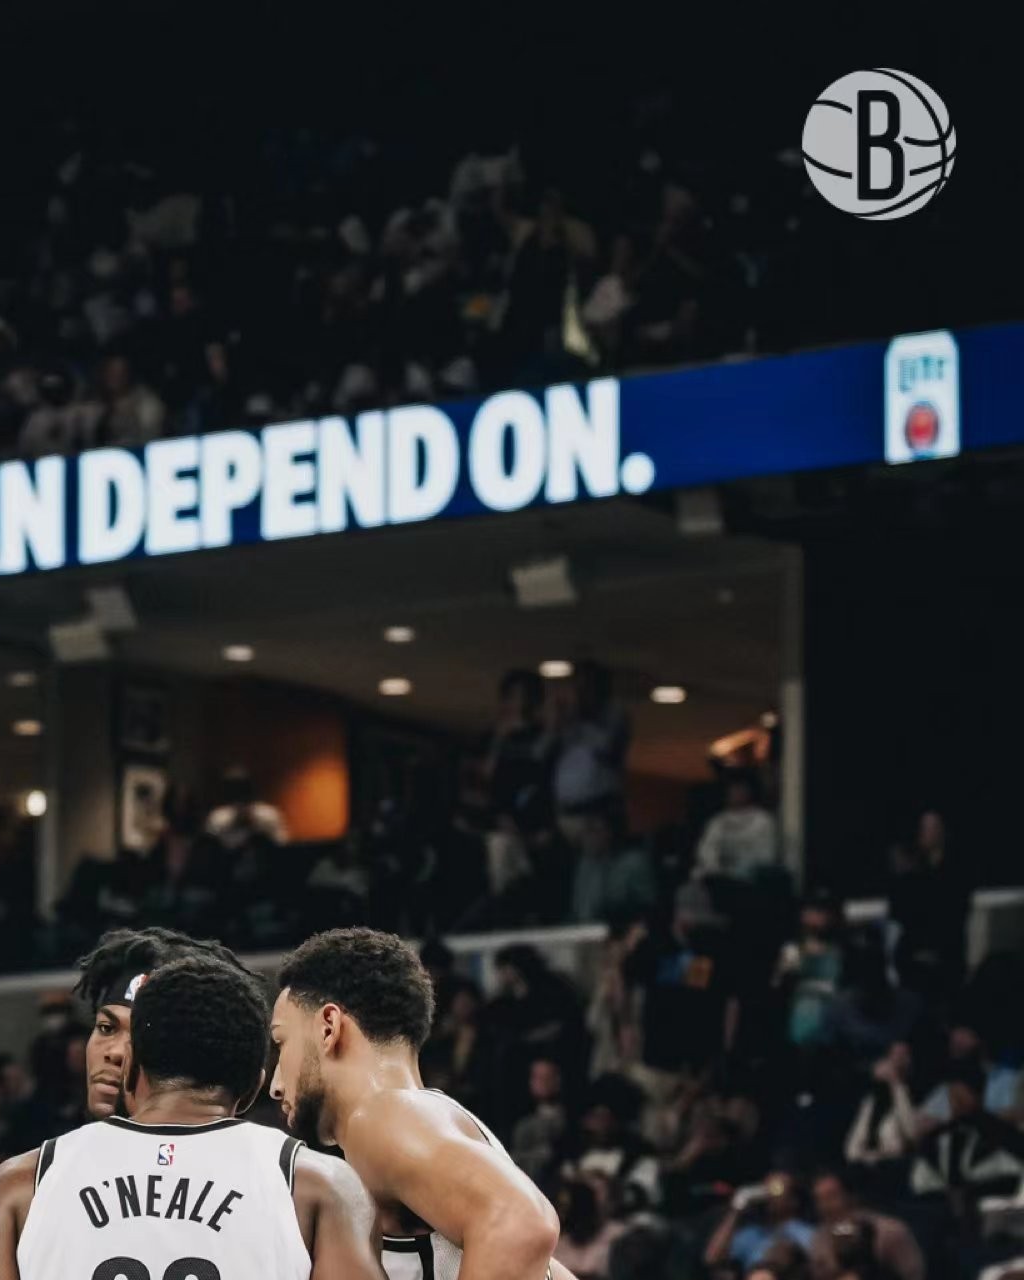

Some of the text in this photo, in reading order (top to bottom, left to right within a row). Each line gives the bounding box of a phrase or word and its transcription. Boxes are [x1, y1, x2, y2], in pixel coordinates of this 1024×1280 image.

[77, 403, 460, 566] DEPEND
[468, 376, 655, 512] ON.
[78, 1173, 245, 1233] O'NEALE
